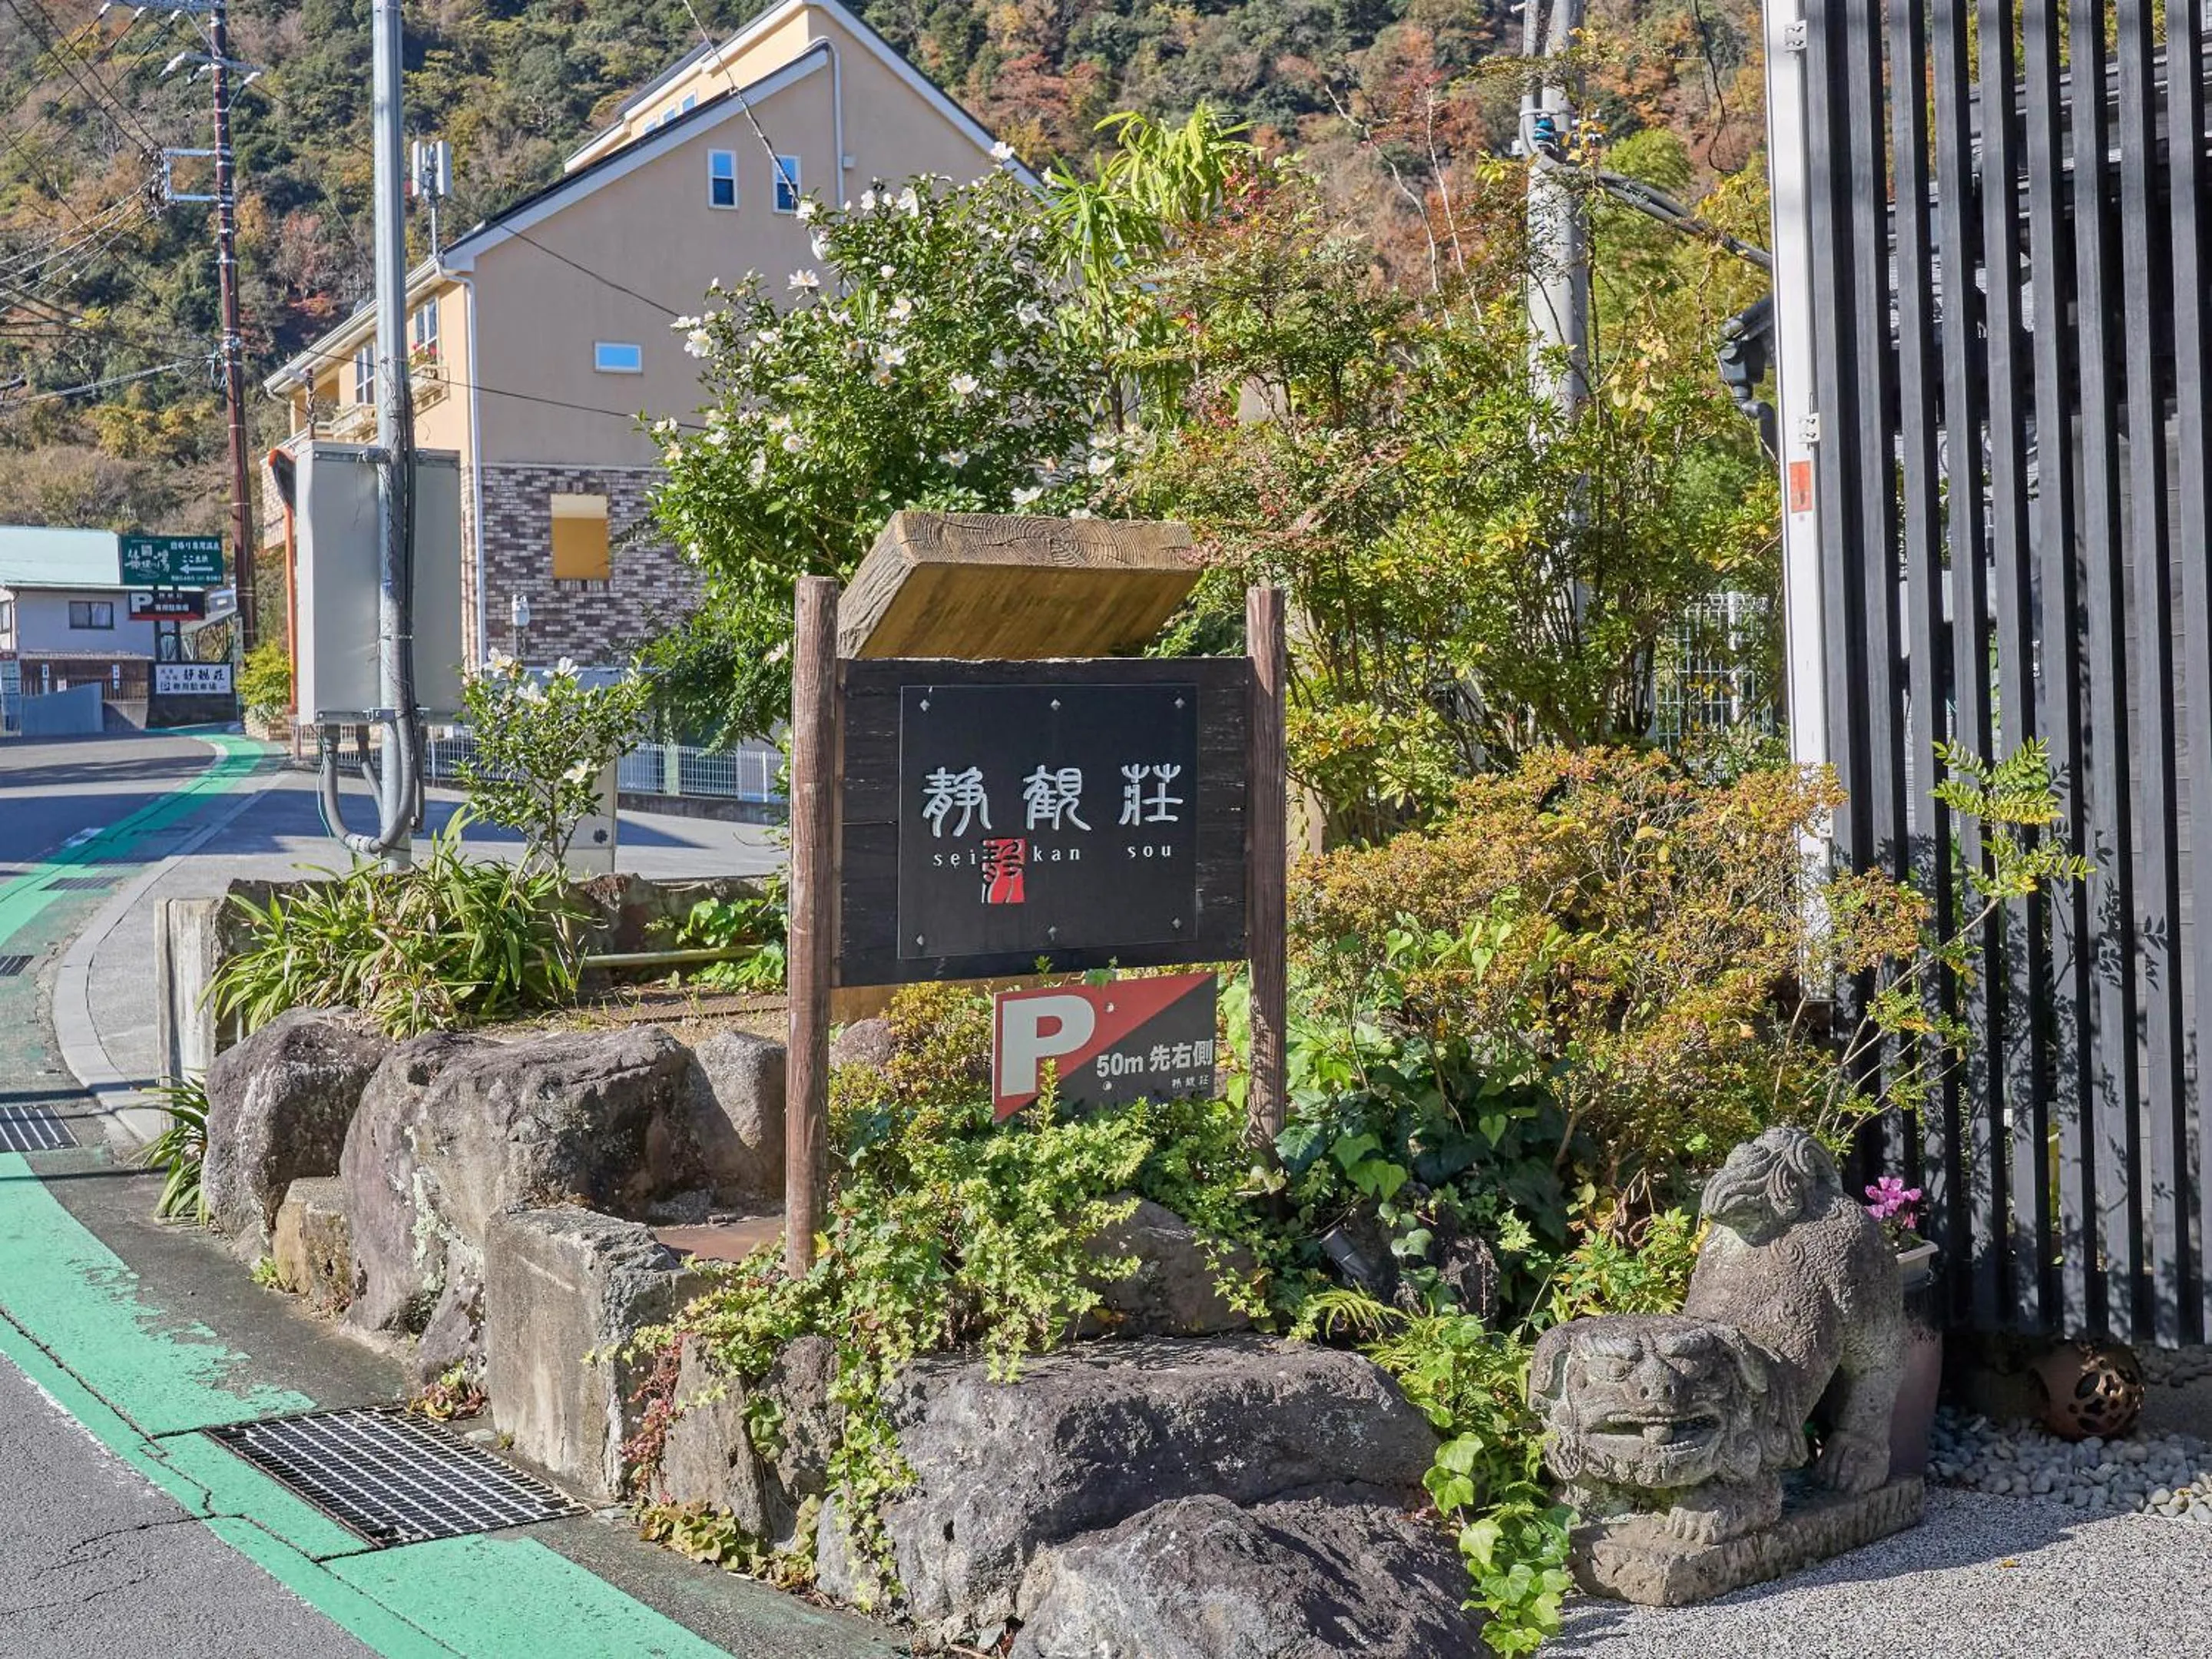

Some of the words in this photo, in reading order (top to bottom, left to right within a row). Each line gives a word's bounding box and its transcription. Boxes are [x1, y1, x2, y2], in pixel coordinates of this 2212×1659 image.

[131, 592, 154, 613] P
[933, 848, 976, 868] sei
[1033, 846, 1081, 862] kan
[1127, 844, 1171, 858] sou
[1001, 995, 1095, 1097] P
[1096, 1052, 1144, 1078] 50m
[1149, 1039, 1214, 1073] 先右側
